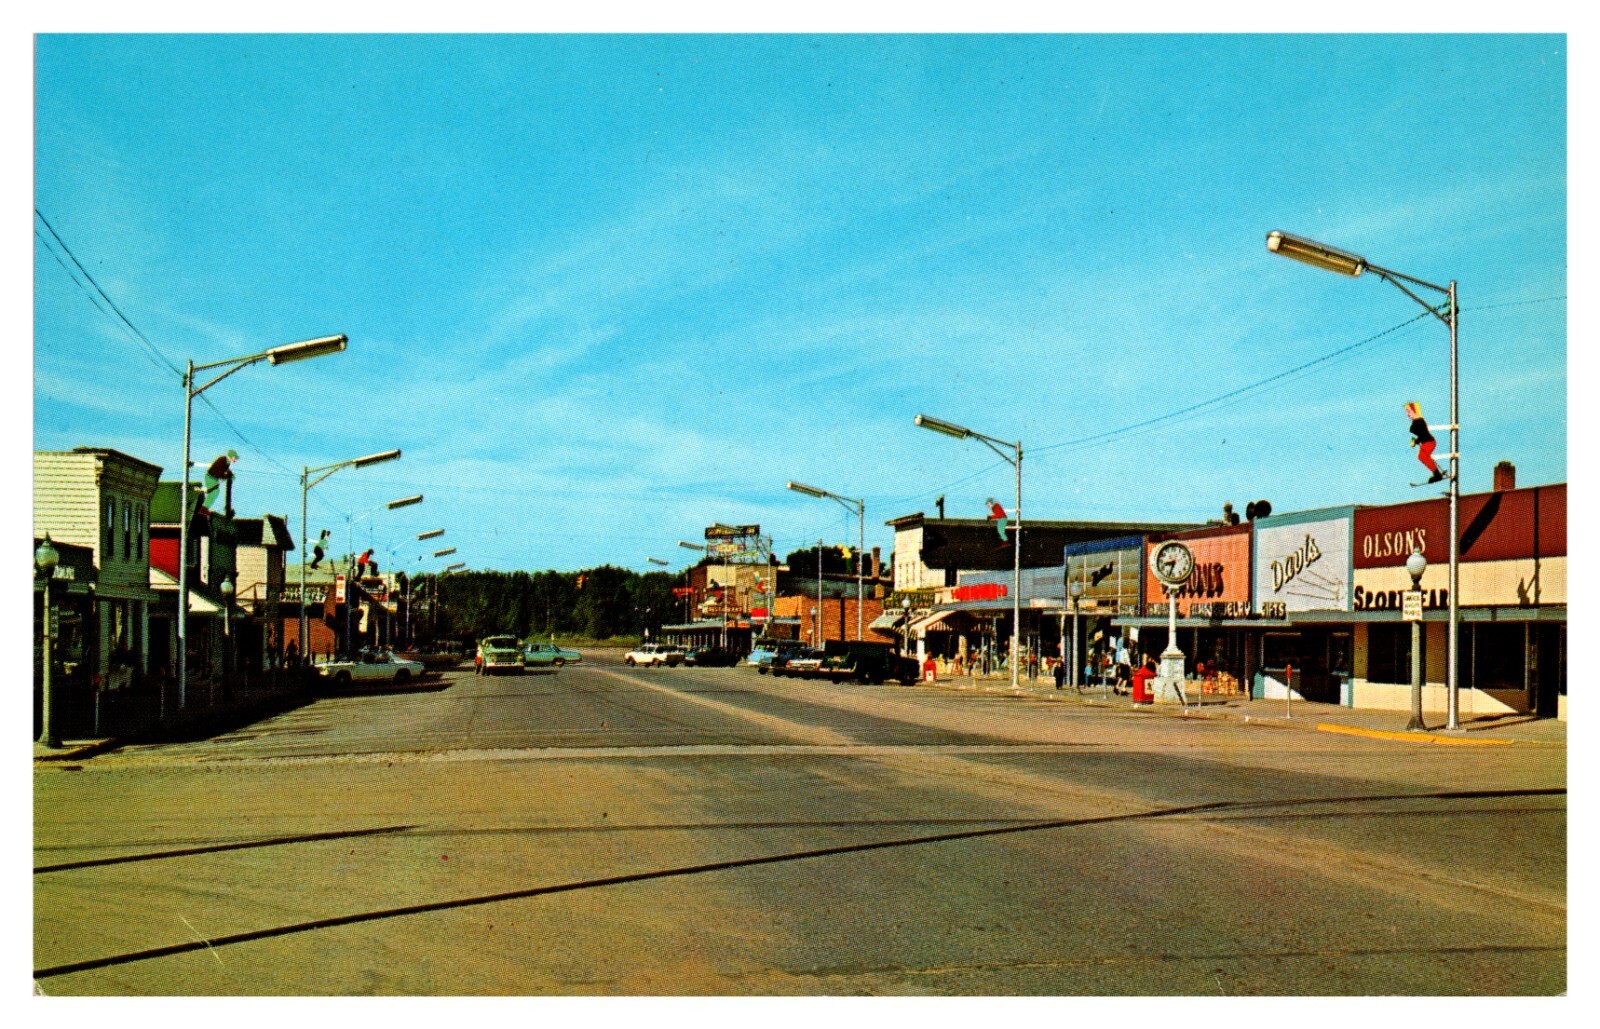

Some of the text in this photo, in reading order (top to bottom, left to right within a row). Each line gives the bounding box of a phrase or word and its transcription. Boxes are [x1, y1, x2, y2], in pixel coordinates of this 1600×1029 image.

[1363, 528, 1426, 558] OLSON'S
[1271, 533, 1322, 593] Davis
[1262, 601, 1287, 619] GIFTS
[1354, 585, 1449, 611] SPORTEAR
